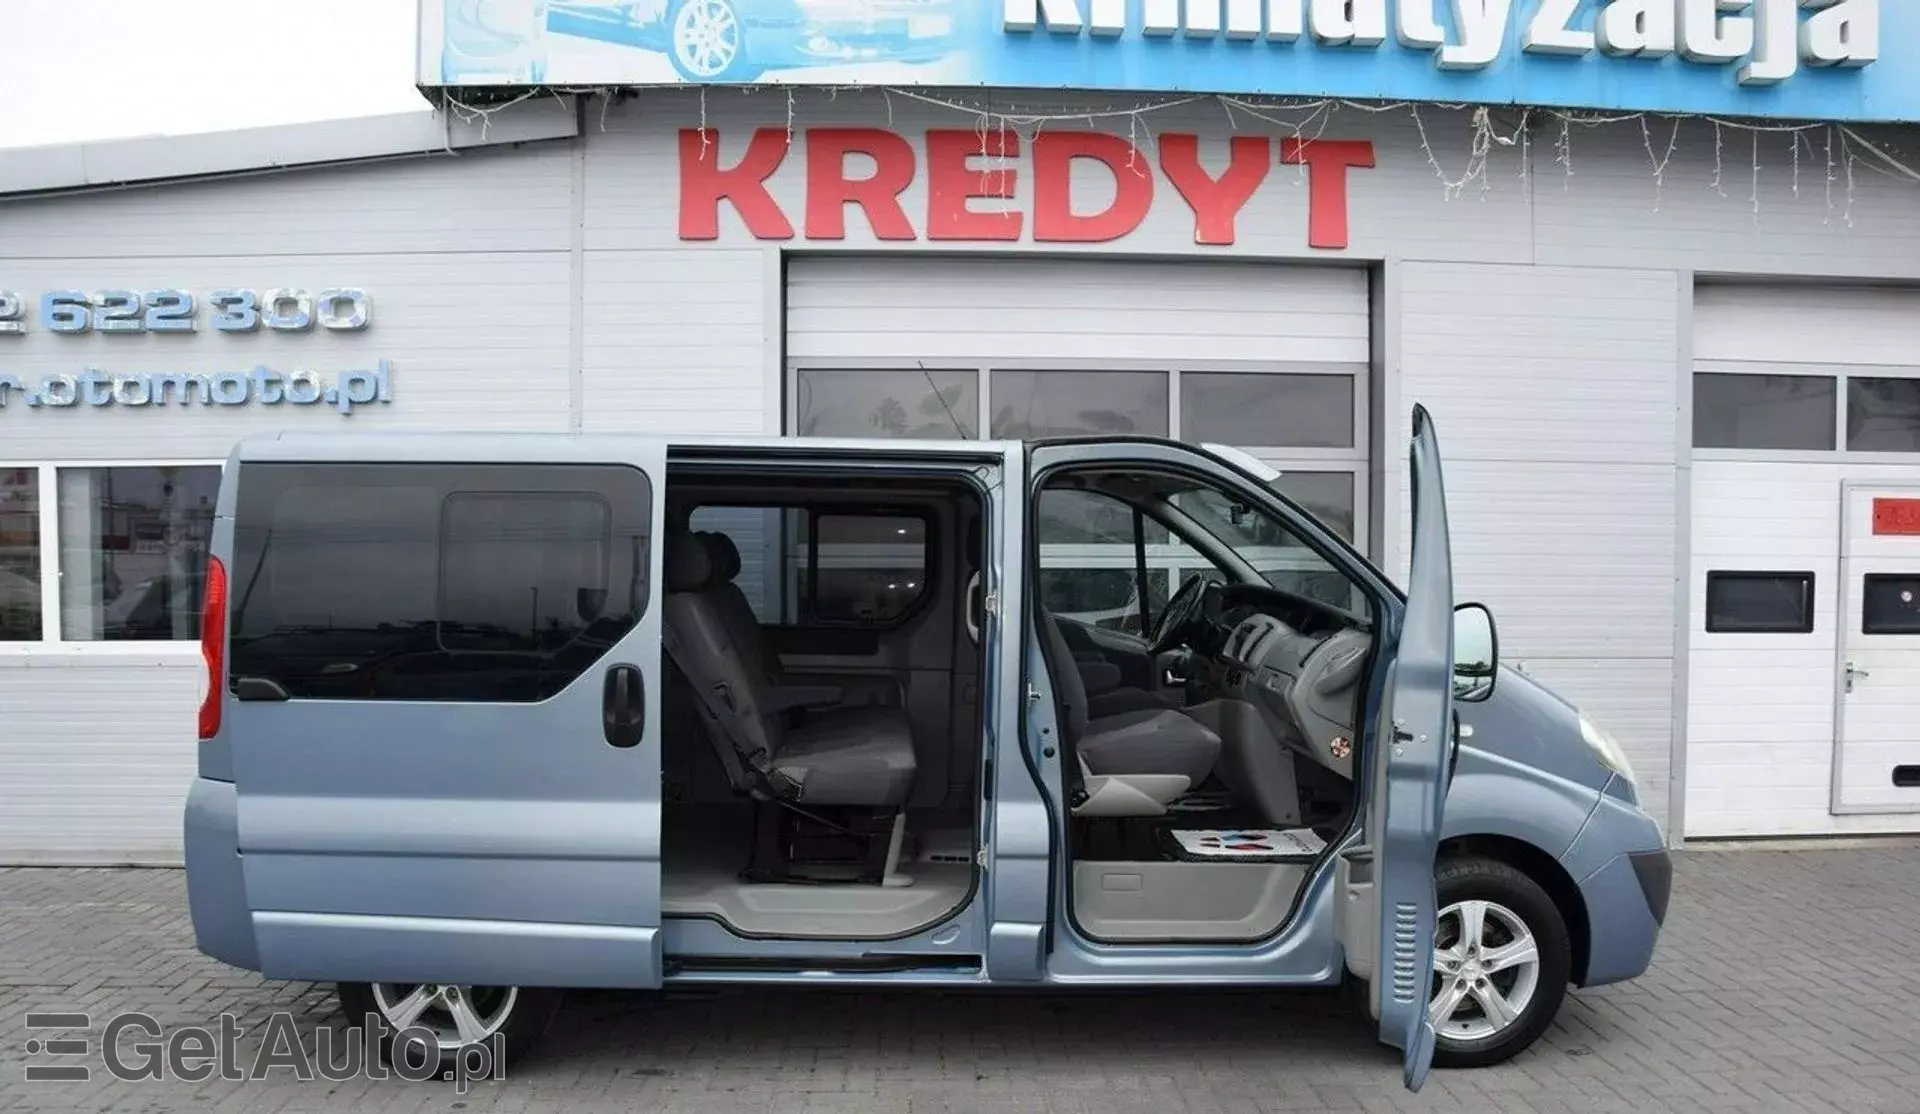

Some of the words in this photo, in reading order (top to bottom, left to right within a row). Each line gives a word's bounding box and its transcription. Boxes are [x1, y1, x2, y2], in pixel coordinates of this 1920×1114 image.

[1003, 0, 1880, 87] ayzacja
[678, 128, 1375, 249] KREDYT
[42, 287, 197, 334] 622
[209, 287, 371, 333] 300
[0, 357, 393, 415] r.otomoto.pl
